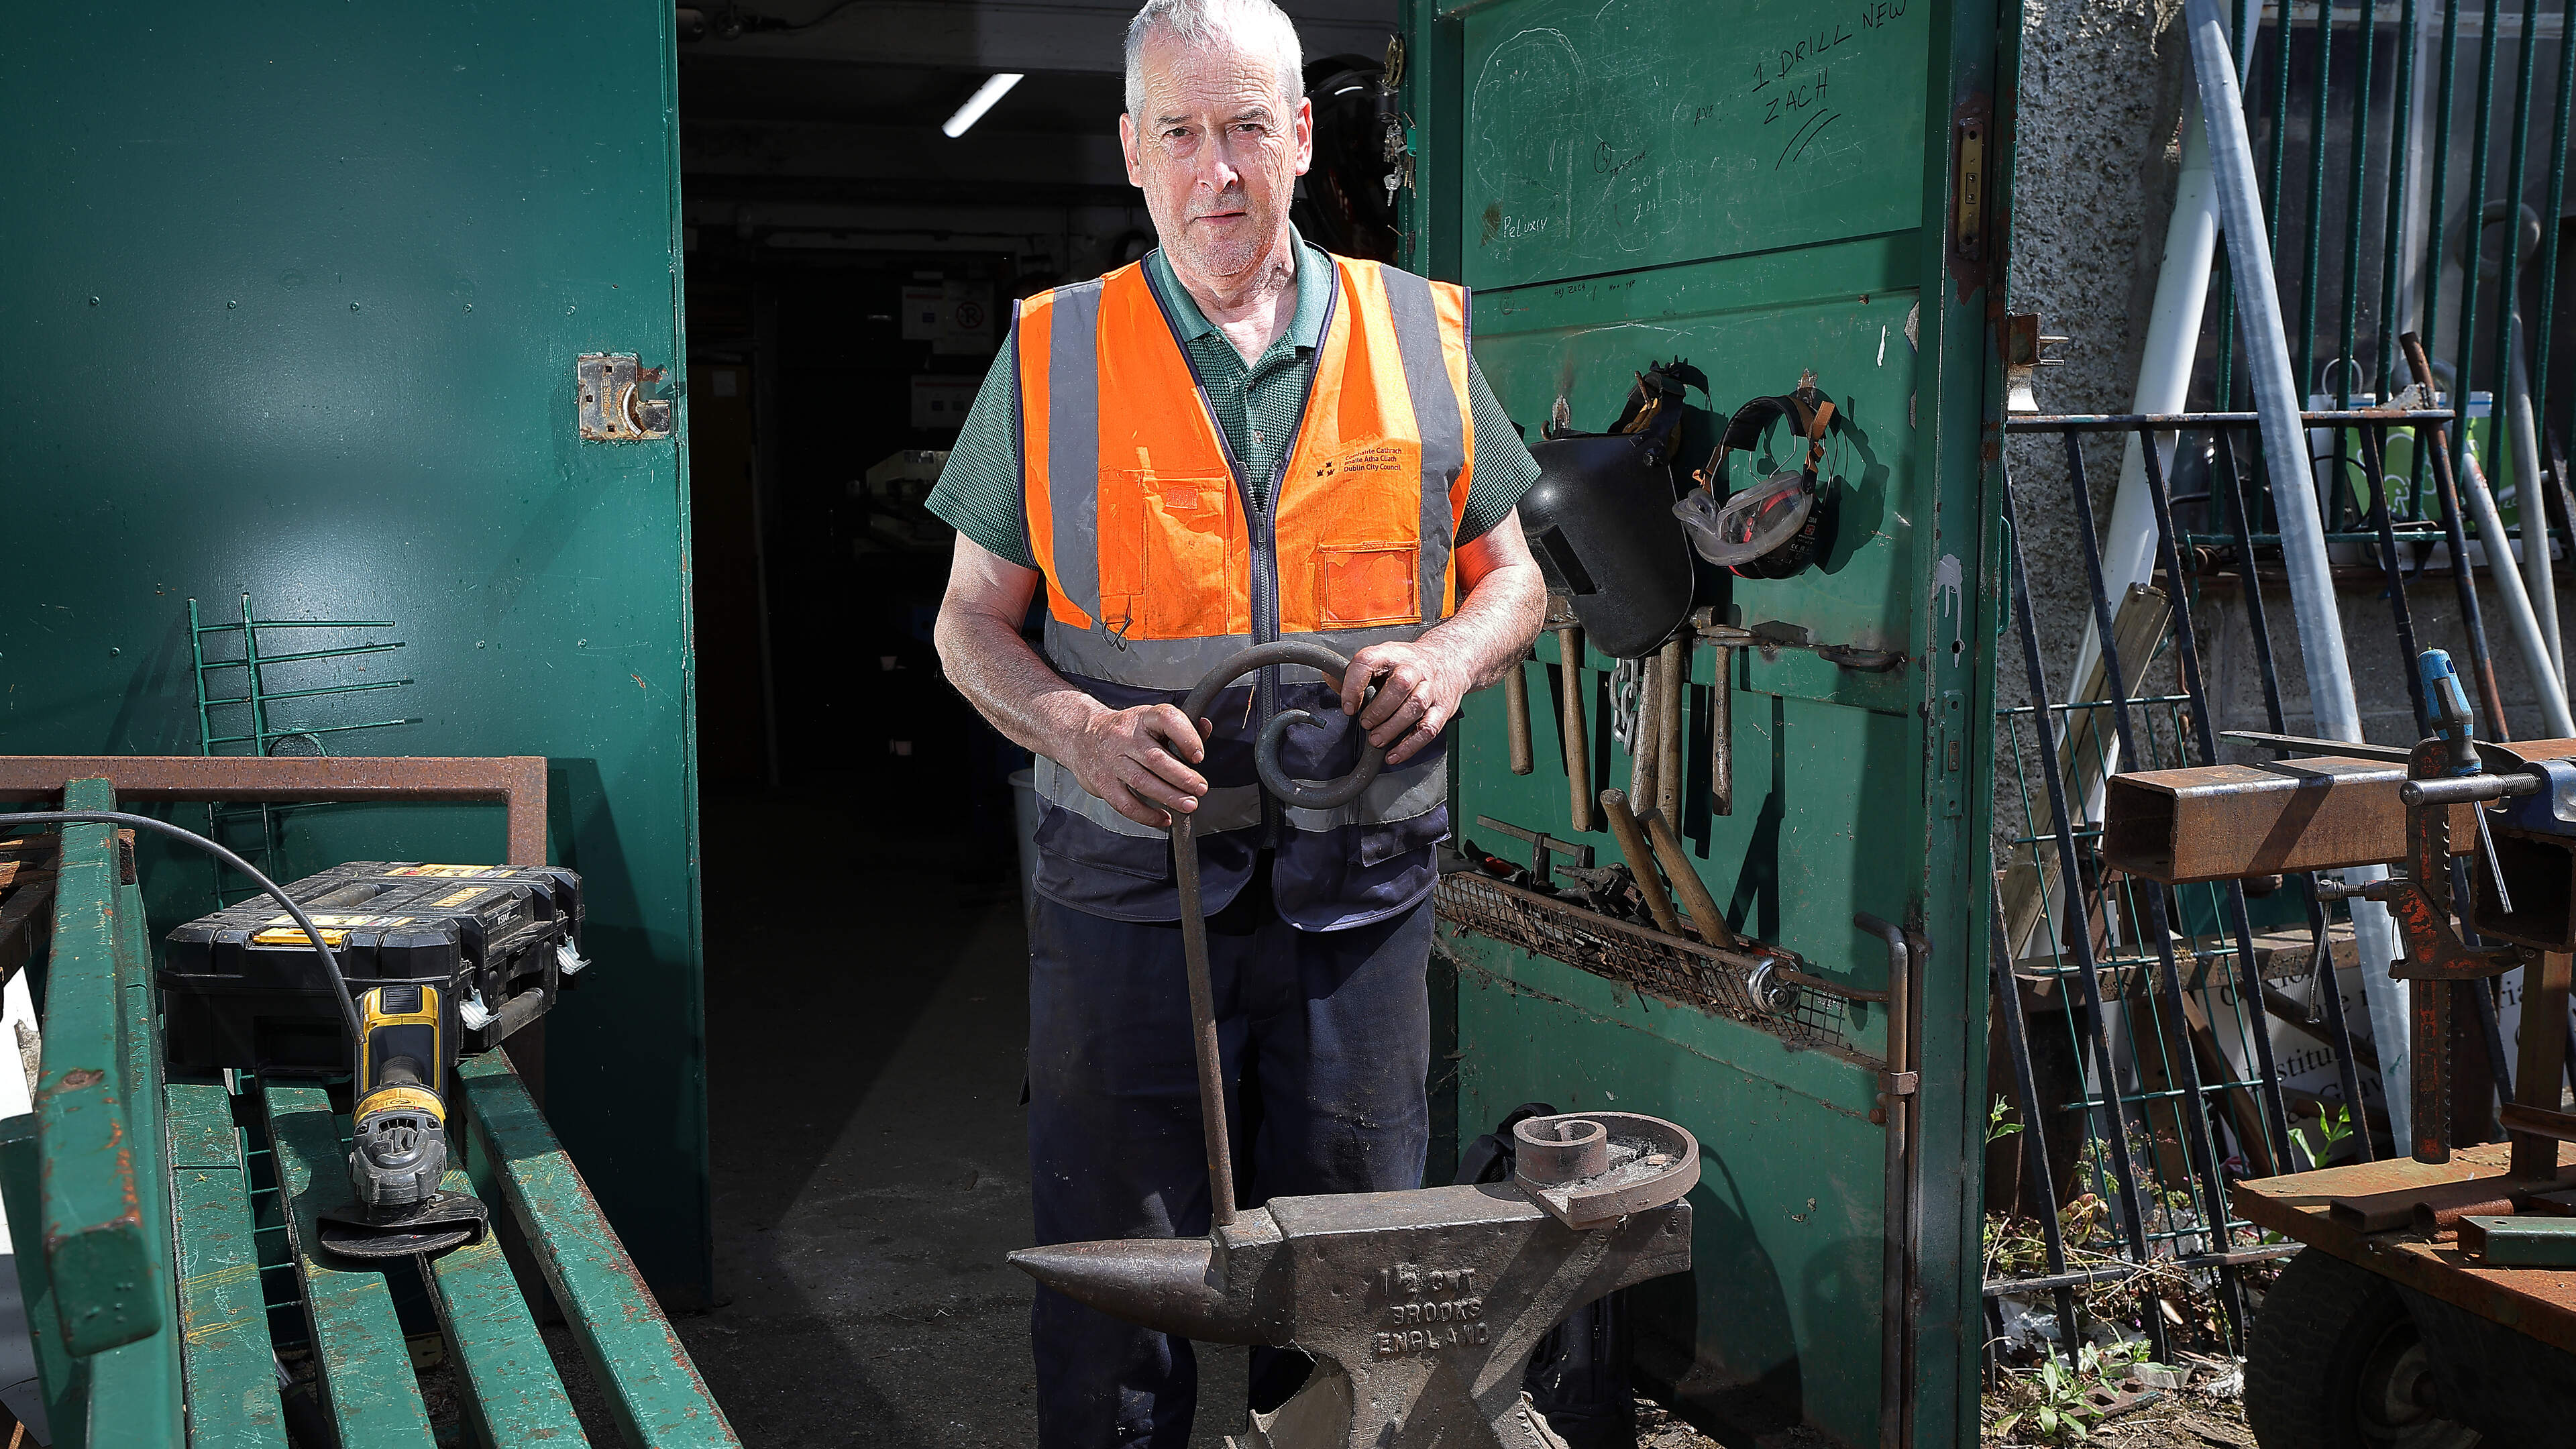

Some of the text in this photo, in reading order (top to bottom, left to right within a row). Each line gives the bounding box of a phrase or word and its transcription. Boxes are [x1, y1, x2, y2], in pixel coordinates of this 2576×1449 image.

[1752, 0, 1907, 93] 1 DRILL NEW
[1764, 67, 1829, 125] ZACH
[1344, 463, 1401, 472] Dublin City Council
[1390, 1297, 1483, 1327] BROOKS
[1376, 1321, 1489, 1354] ENGLAND
